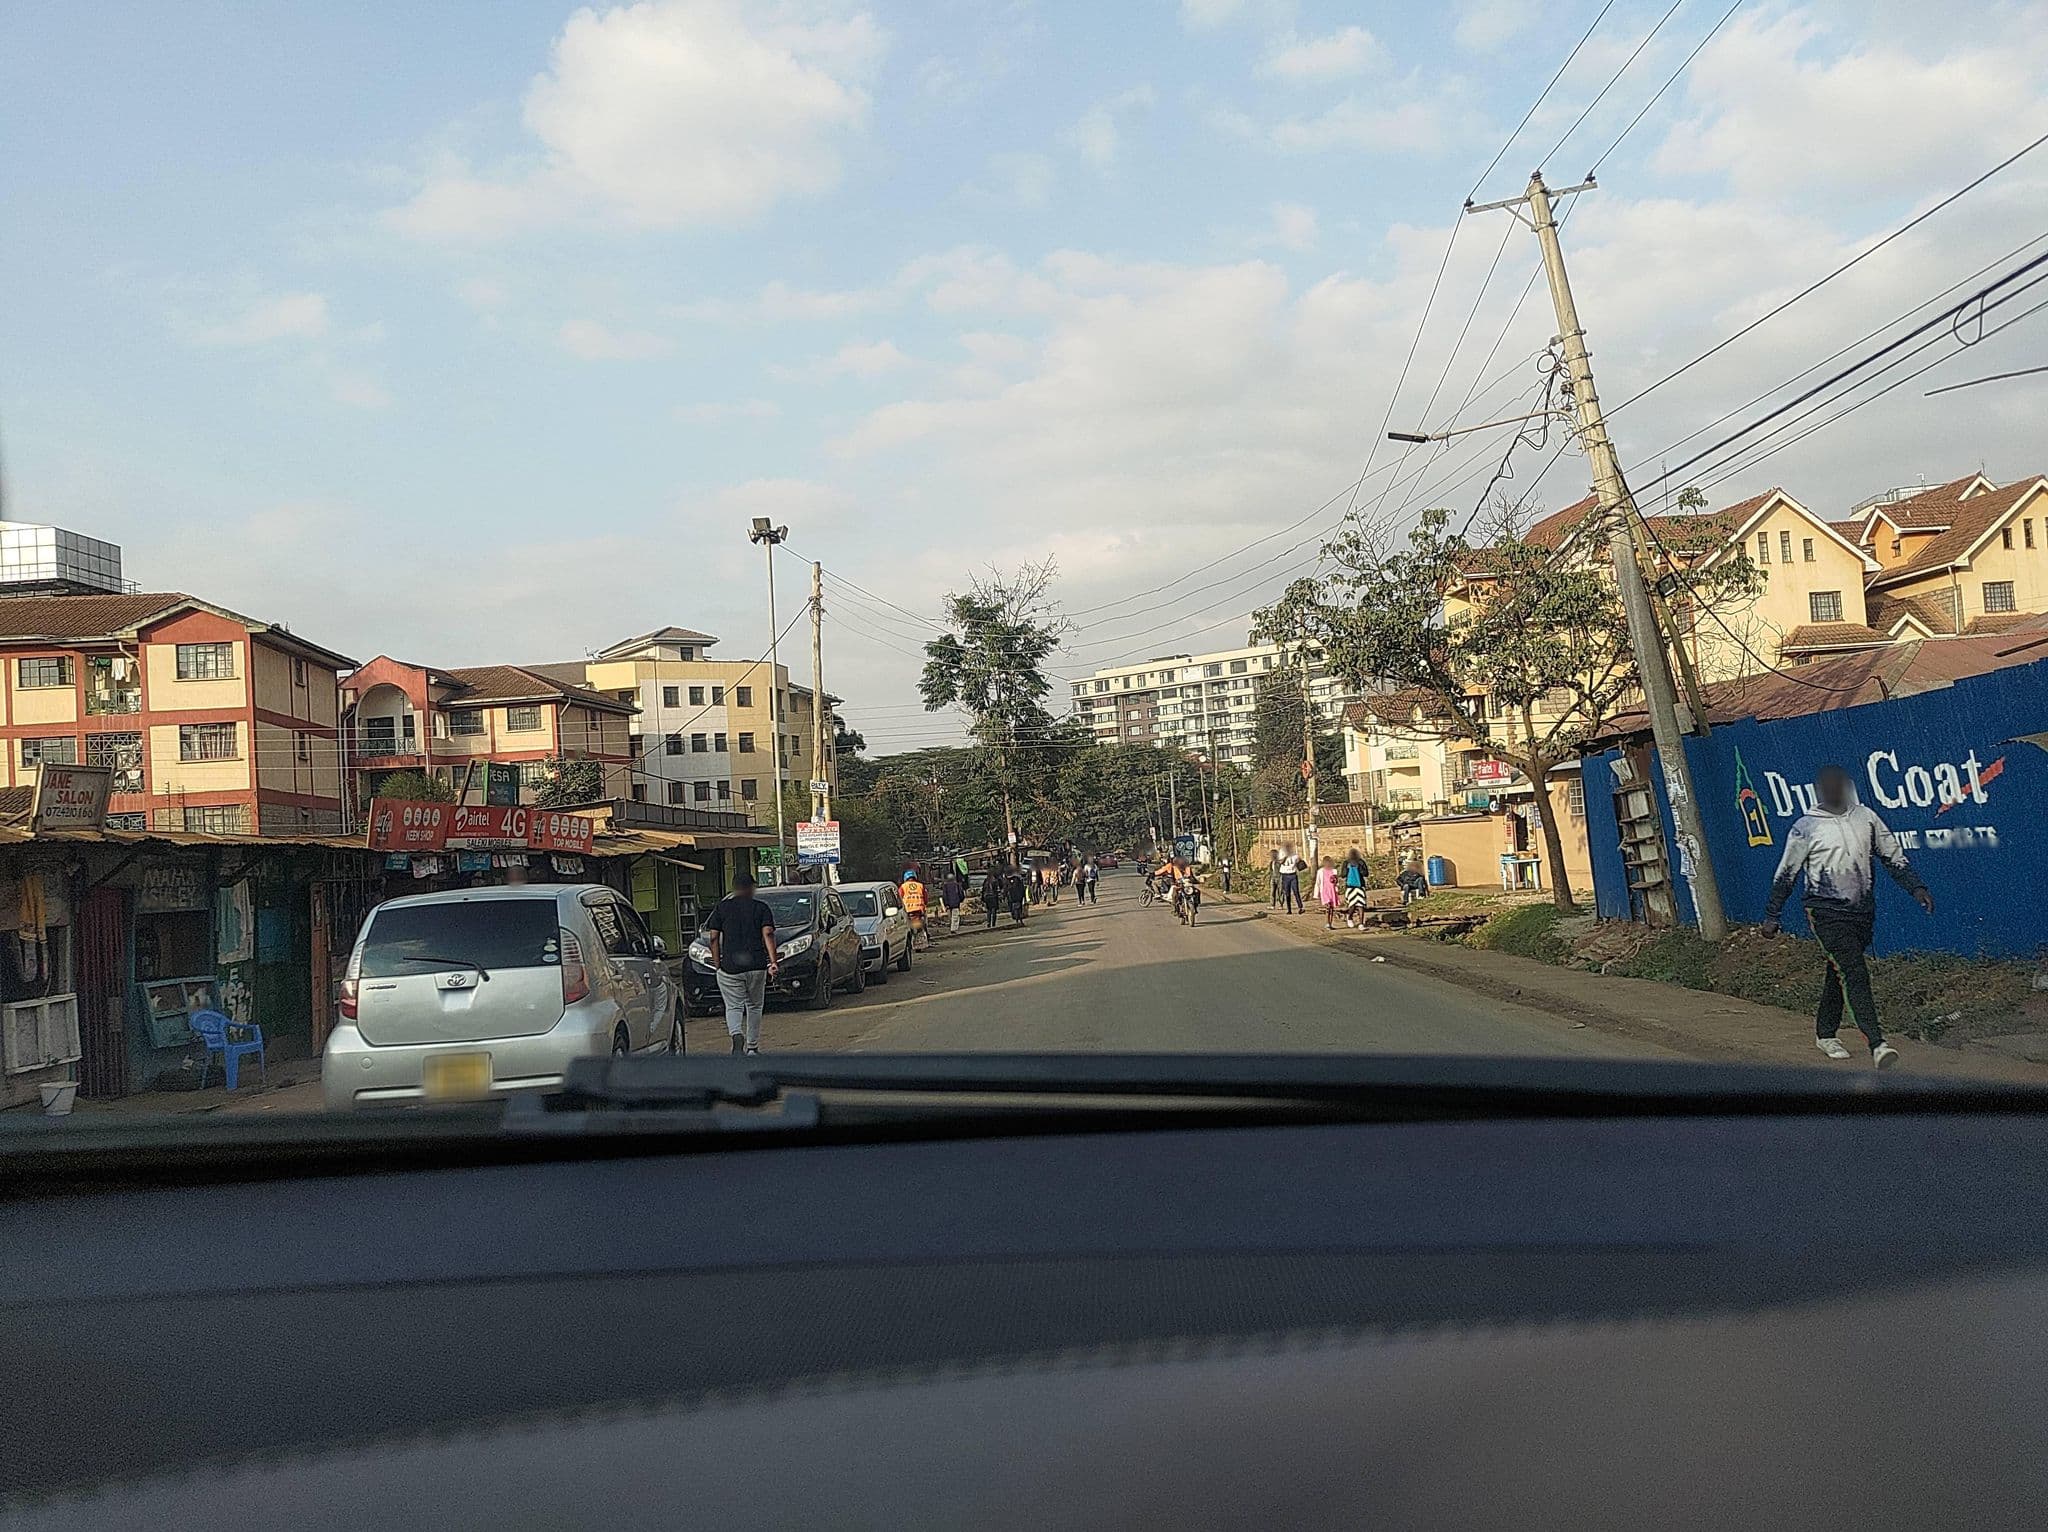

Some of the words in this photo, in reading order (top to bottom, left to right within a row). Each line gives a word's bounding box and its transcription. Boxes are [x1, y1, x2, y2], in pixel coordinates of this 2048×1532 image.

[1498, 762, 1509, 776] 4G
[45, 773, 73, 789] JANE
[1867, 750, 1988, 808] Coat
[56, 790, 94, 805] SALON
[468, 812, 490, 826] airtel
[501, 808, 526, 837] 4G
[420, 830, 434, 841] SHOP
[488, 838, 512, 848] MOBILES
[553, 837, 564, 847] TOP
[565, 839, 584, 850] MOBILE
